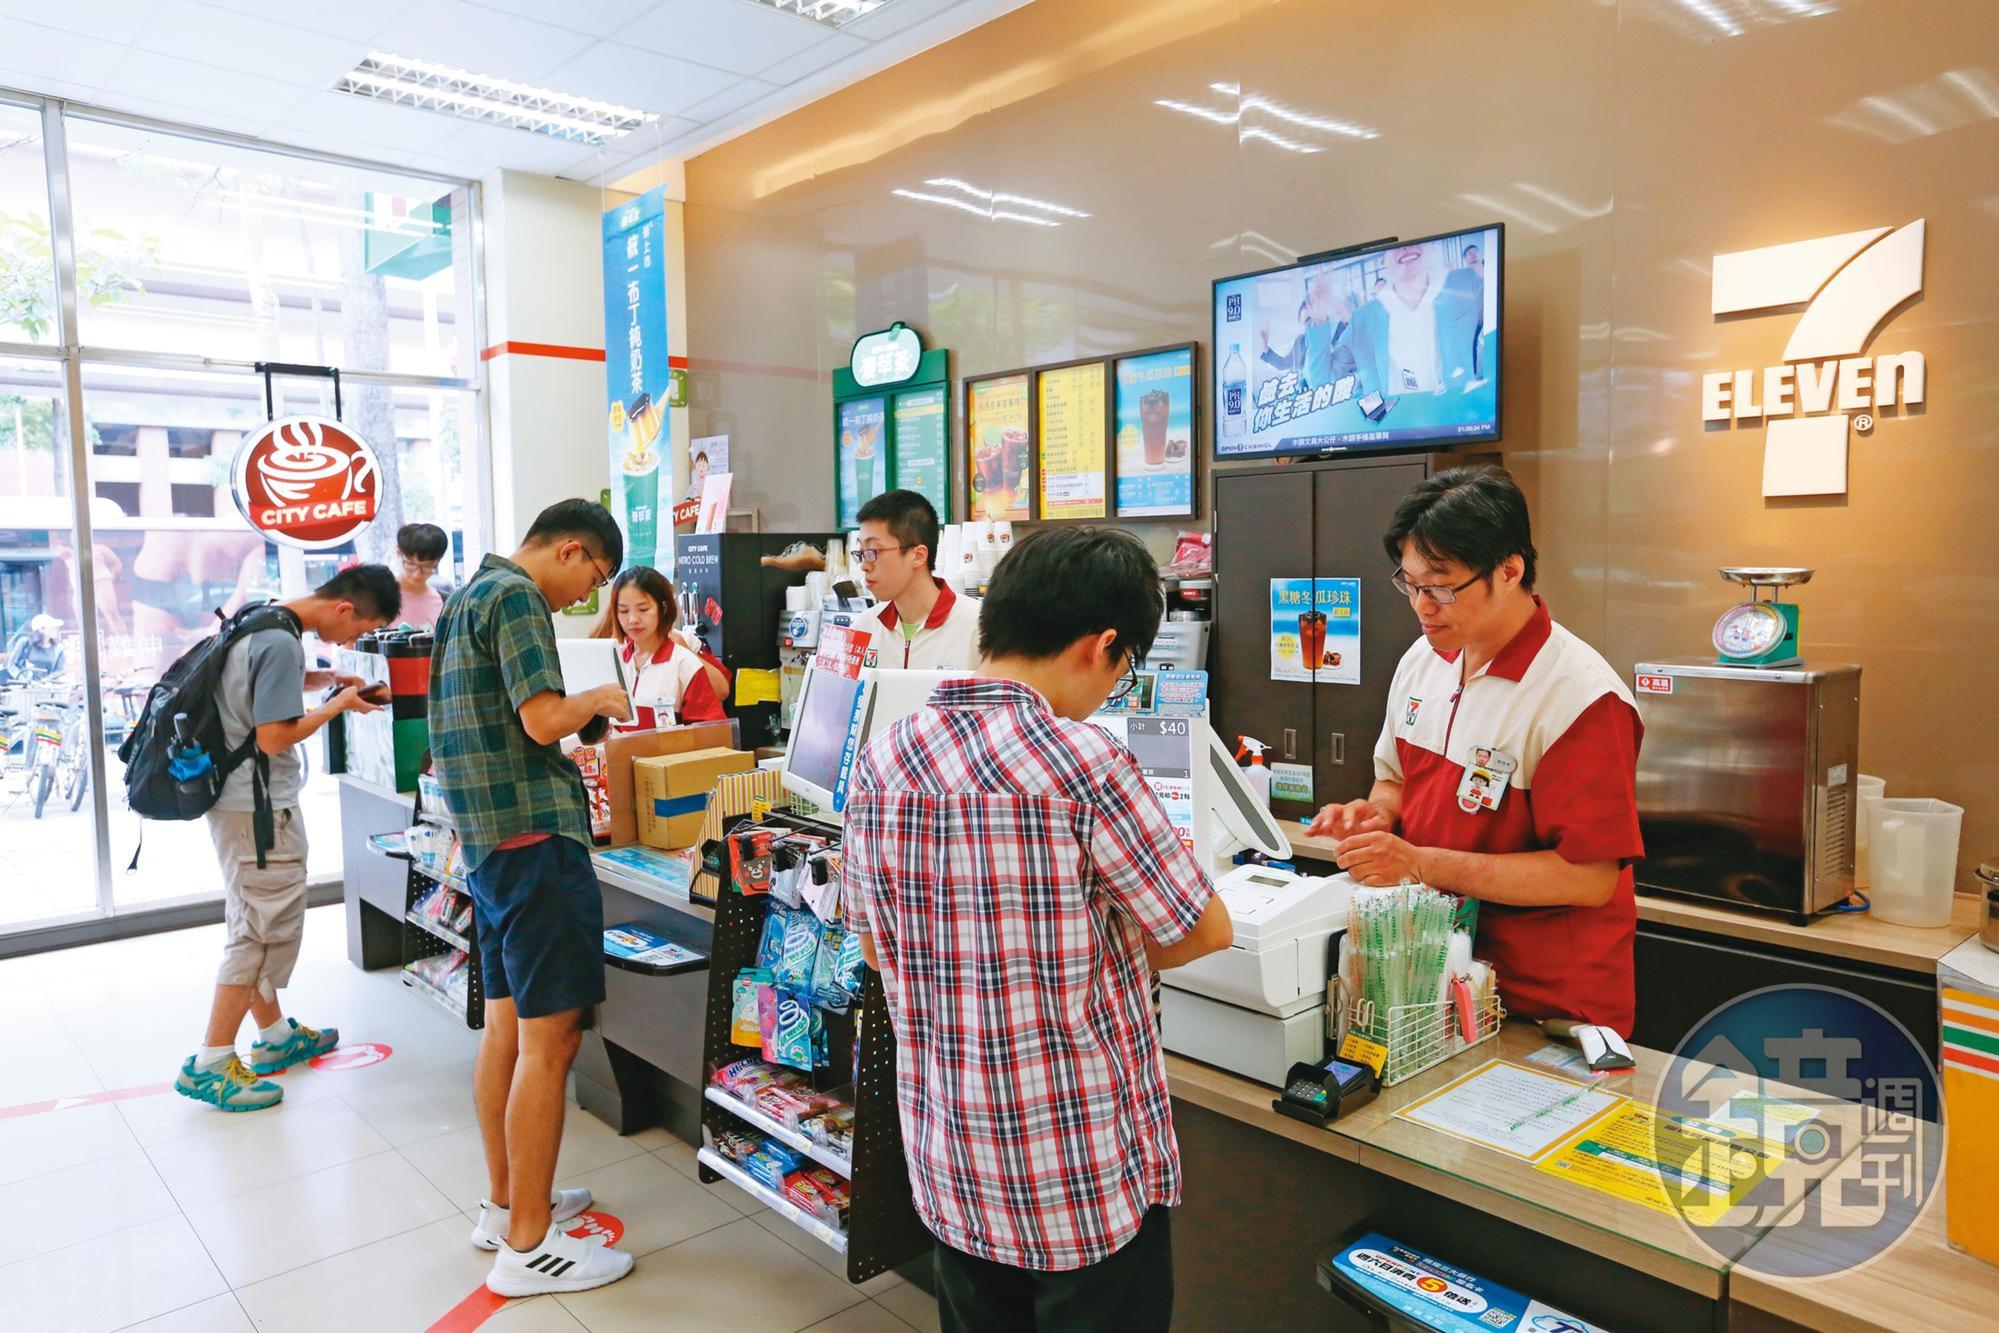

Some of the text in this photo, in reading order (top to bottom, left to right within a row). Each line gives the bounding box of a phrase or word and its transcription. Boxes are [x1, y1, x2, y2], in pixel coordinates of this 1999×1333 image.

[627, 234, 643, 394] 統一布丁純奶茶
[1711, 217, 1926, 496] 7
[261, 499, 368, 526] CITY CAFE
[680, 502, 701, 521] CAFE
[1278, 590, 1352, 605] 黑糖冬瓜珍珠
[1129, 720, 1187, 736] 小計 $40
[1356, 1251, 1417, 1282] 週六日消費
[1421, 1278, 1446, 1293] 5
[1443, 1291, 1474, 1307] 倍送
